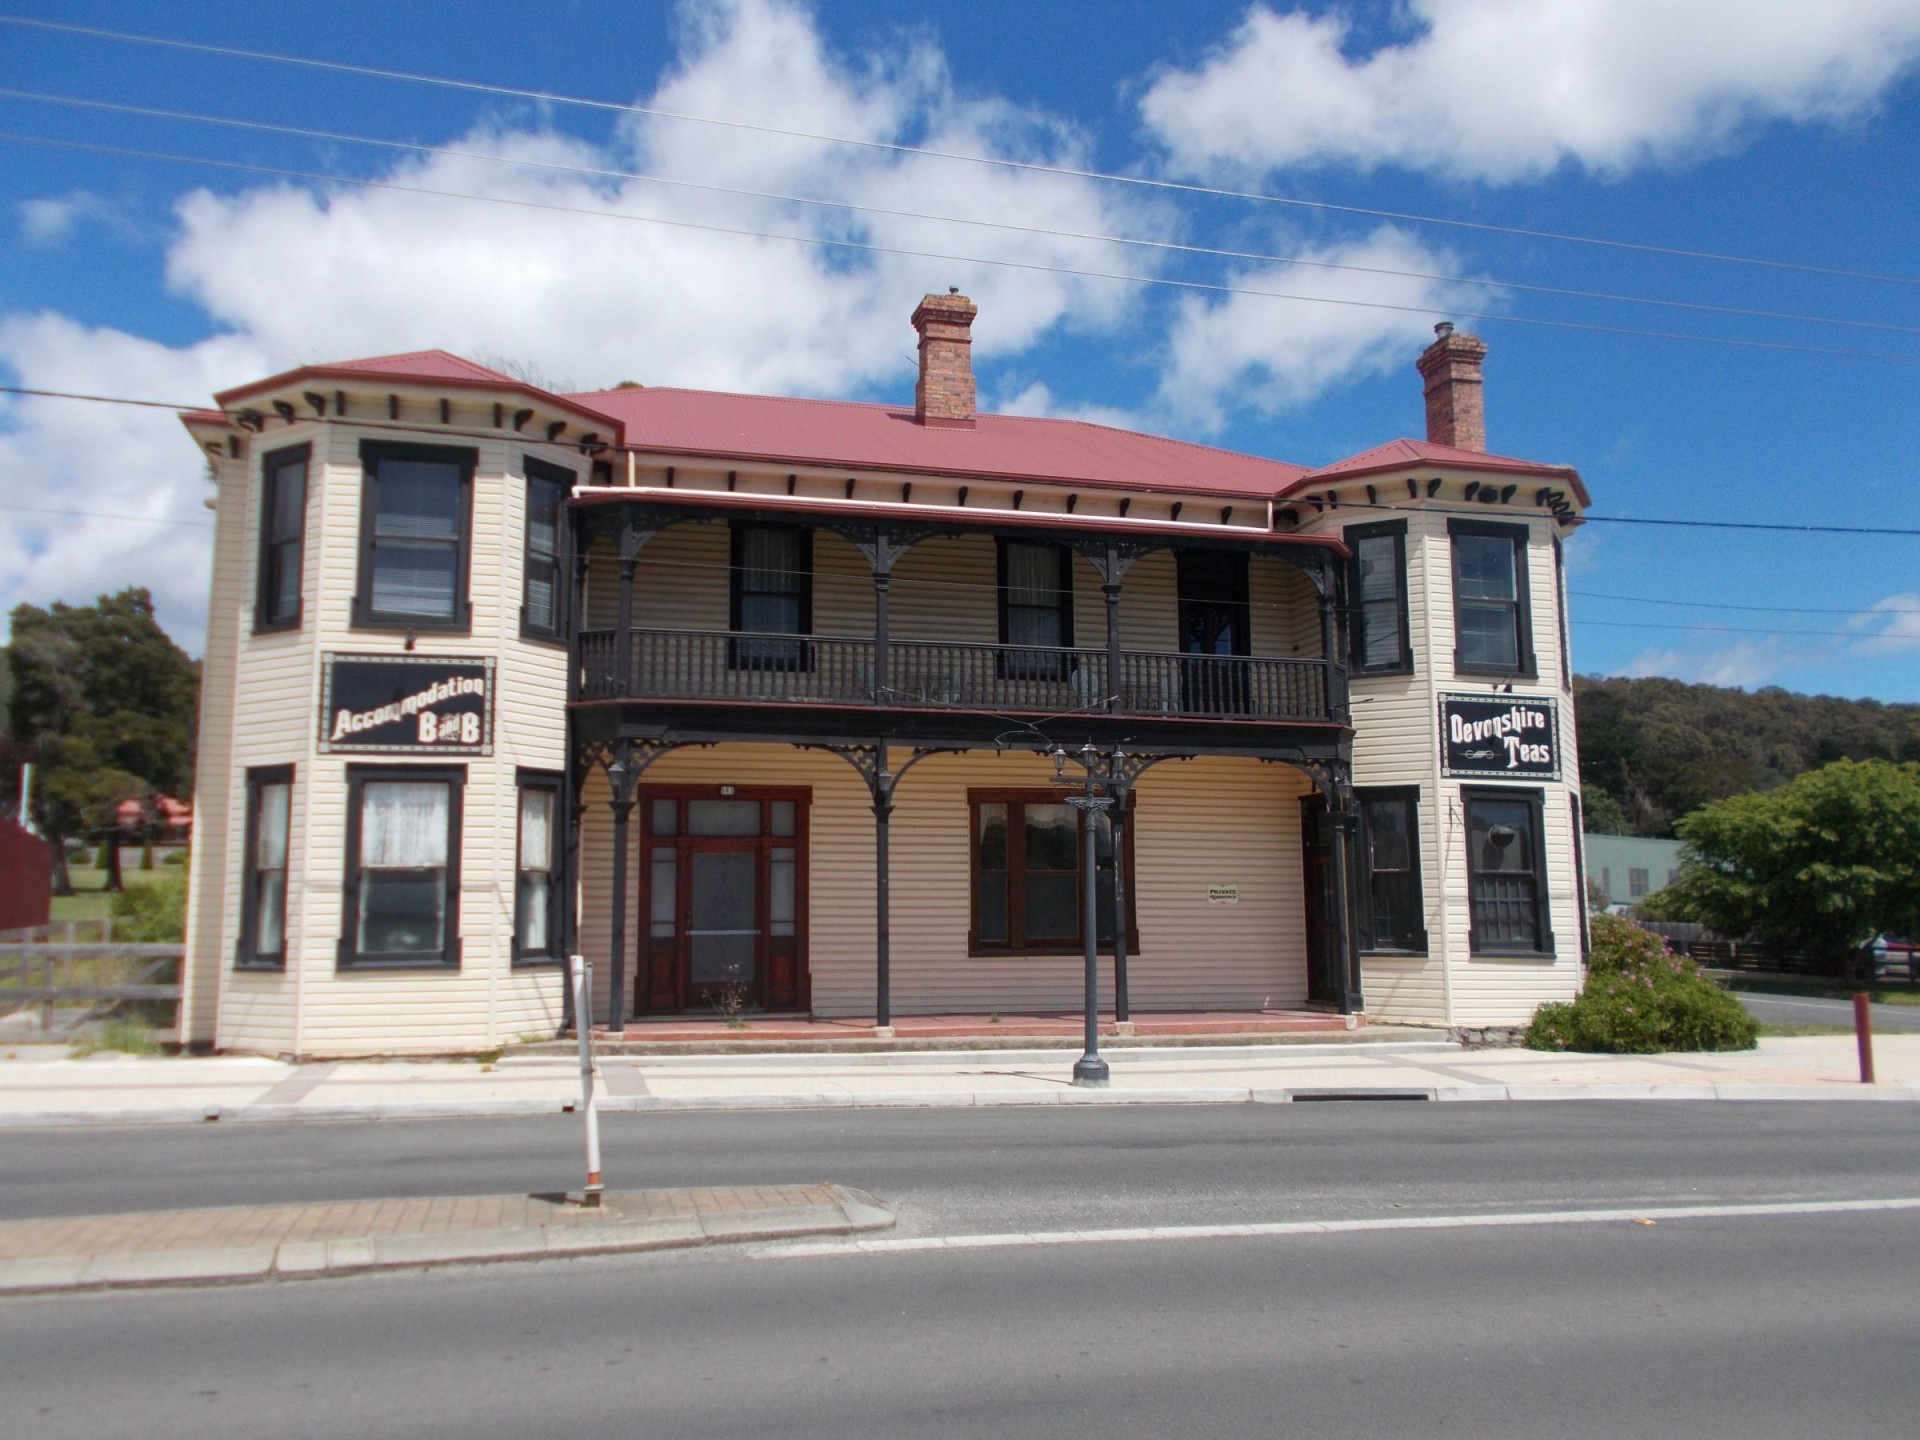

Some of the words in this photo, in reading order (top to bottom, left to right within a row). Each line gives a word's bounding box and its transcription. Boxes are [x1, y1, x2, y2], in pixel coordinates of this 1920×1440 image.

[330, 677, 484, 741] Accommodation
[1450, 706, 1545, 743] Devonshire
[418, 711, 437, 743] B
[461, 712, 480, 743] B
[1503, 736, 1550, 769] Teas
